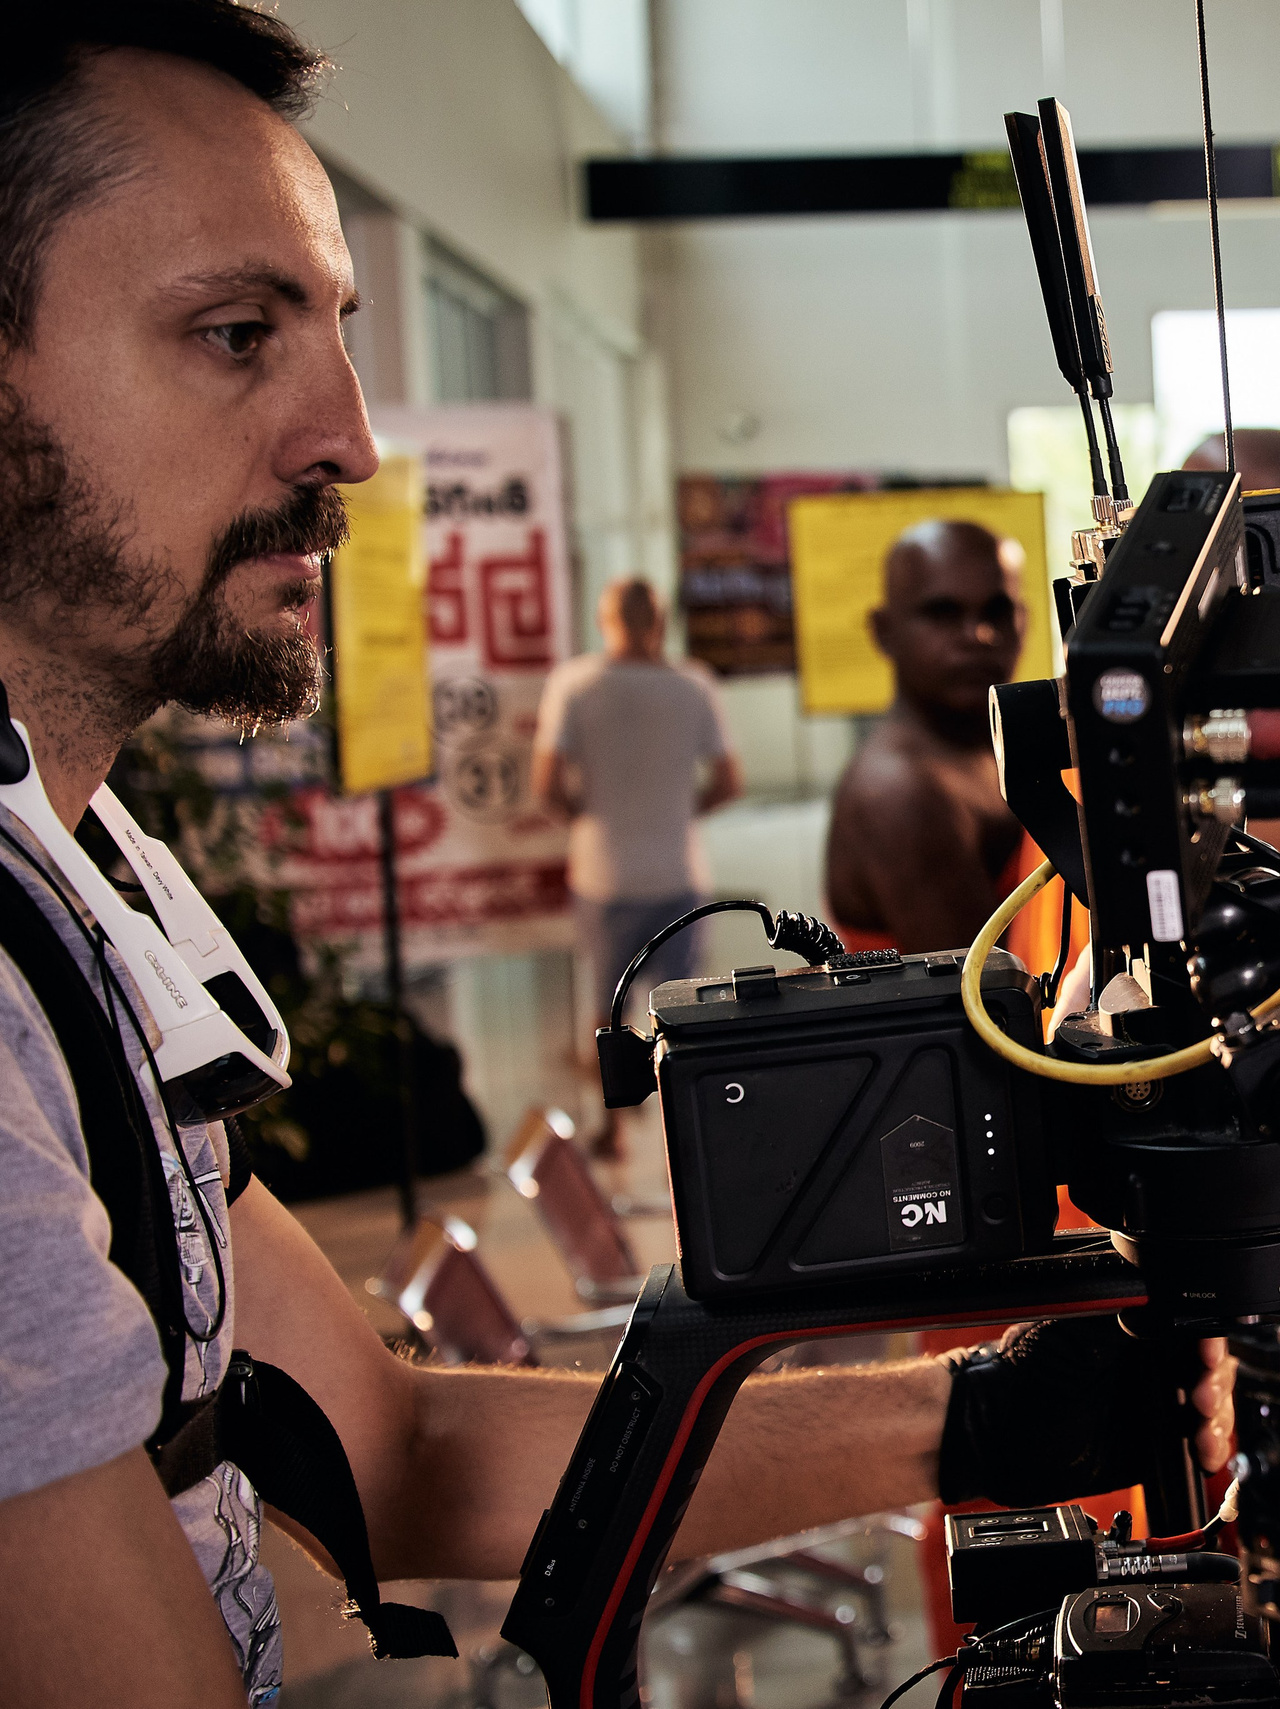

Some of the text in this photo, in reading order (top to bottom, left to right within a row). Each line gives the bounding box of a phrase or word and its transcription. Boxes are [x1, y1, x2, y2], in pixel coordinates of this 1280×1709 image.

[125, 829, 137, 845] Made
[140, 851, 154, 870] Taiwan
[892, 1190, 951, 1203] NO COMMENTS
[900, 1200, 948, 1228] NC
[1189, 1291, 1216, 1299] UNLOCK
[609, 1407, 641, 1472] DO NOT OBSTRUCT
[568, 1457, 596, 1513] ANTENNA INSIDE
